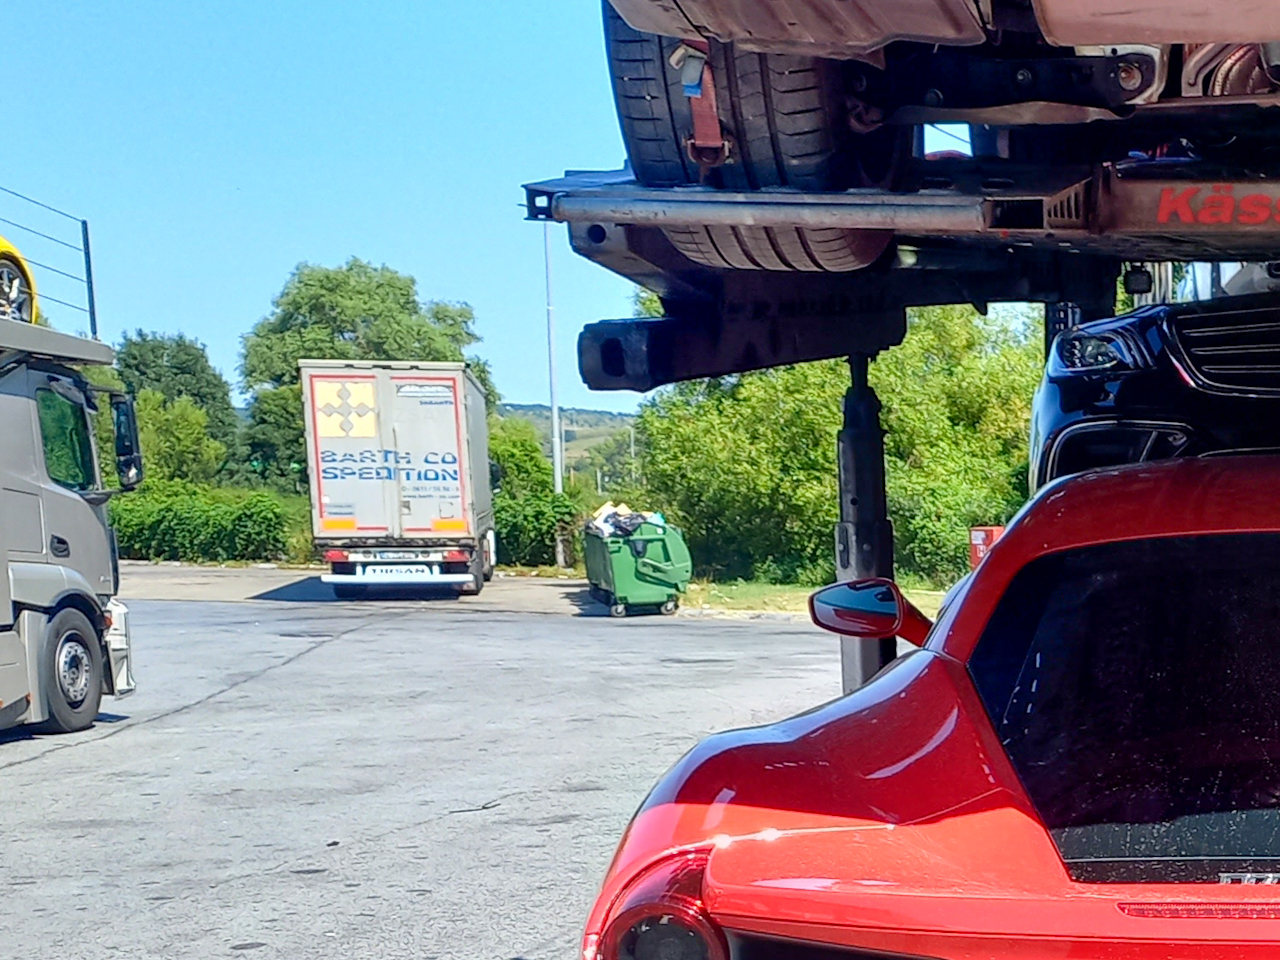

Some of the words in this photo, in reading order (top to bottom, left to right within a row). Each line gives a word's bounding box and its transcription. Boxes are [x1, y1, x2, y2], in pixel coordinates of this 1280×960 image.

[320, 450, 410, 464] BARTH
[423, 452, 457, 465] CO
[321, 467, 458, 481] SPEDITION
